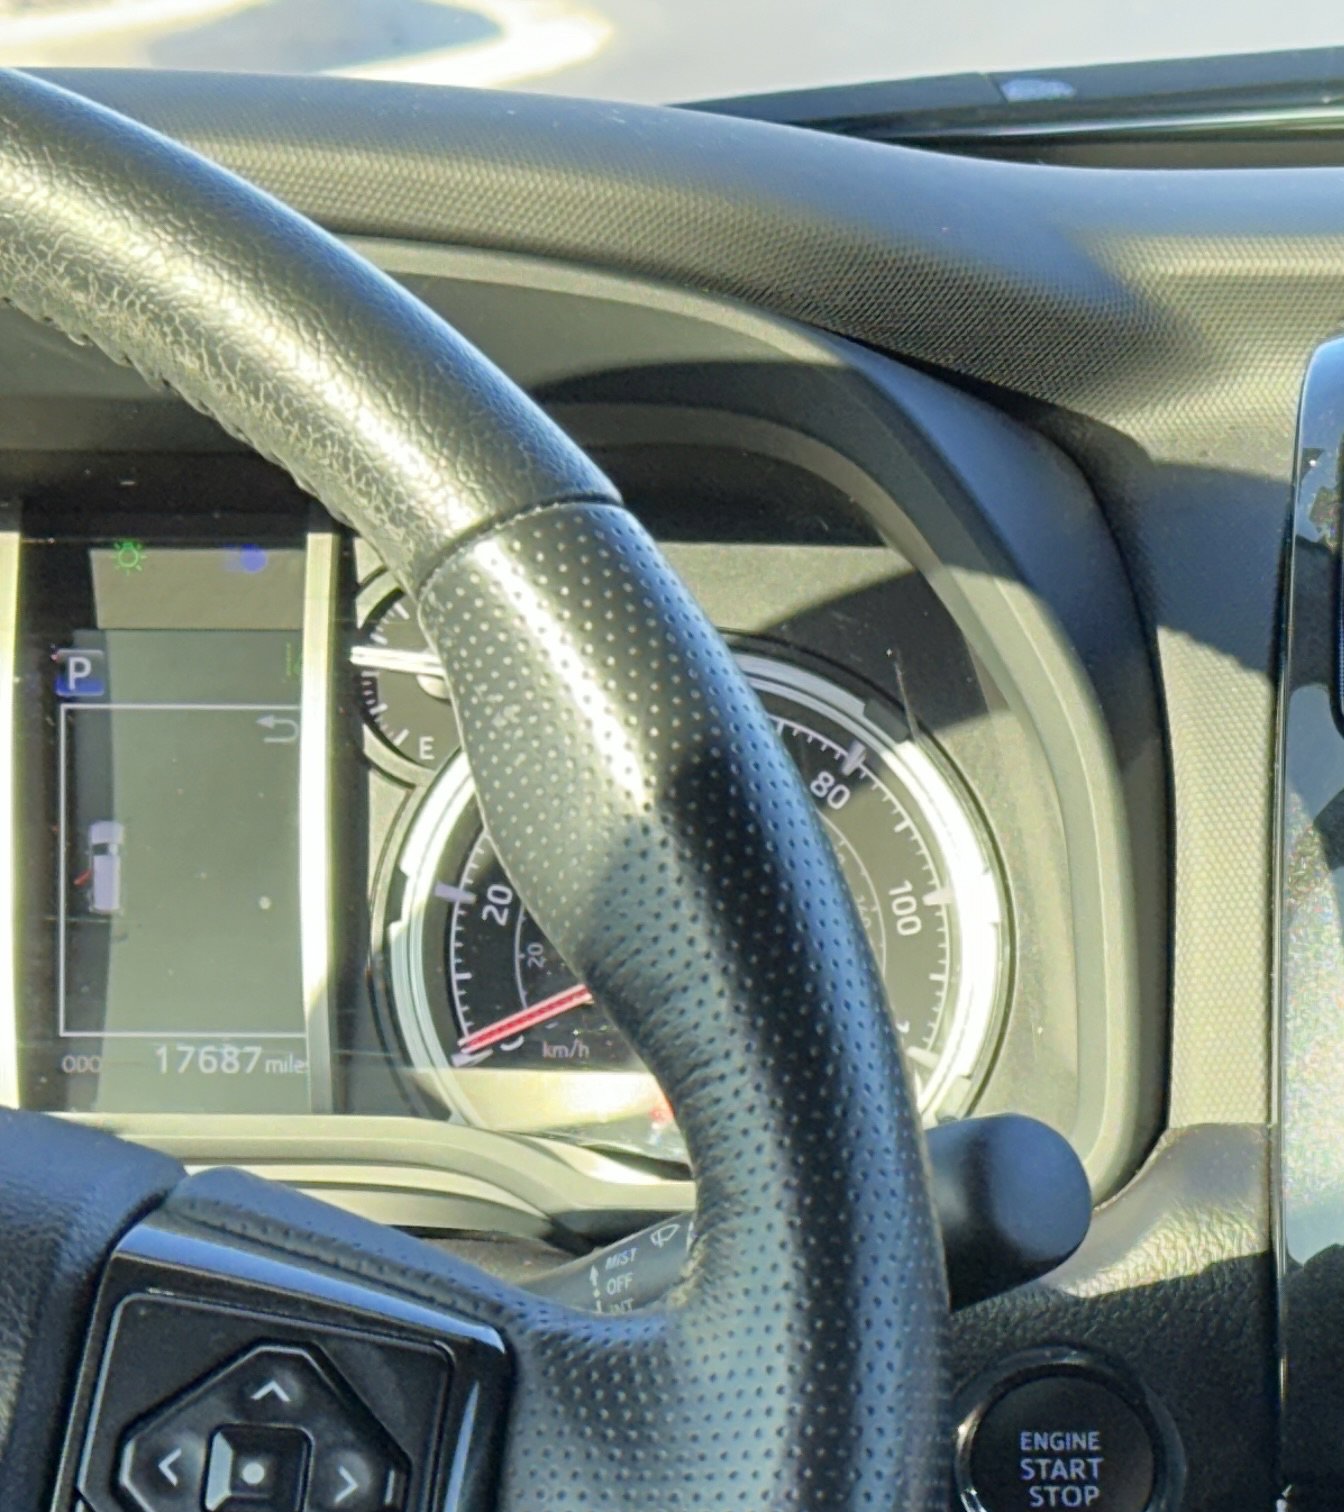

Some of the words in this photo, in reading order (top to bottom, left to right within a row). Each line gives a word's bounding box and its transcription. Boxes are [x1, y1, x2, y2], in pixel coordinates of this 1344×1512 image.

[68, 656, 92, 691] P
[419, 735, 435, 760] E
[810, 770, 851, 811] 80
[481, 883, 514, 927] 20
[888, 879, 923, 937] 100
[526, 941, 545, 969] 20
[155, 1043, 263, 1075] 17687
[541, 1039, 590, 1059] km/h
[605, 1271, 634, 1297] OFF
[1019, 1431, 1101, 1451] ENGINE
[1020, 1457, 1104, 1481] START
[1028, 1485, 1101, 1508] STOP
